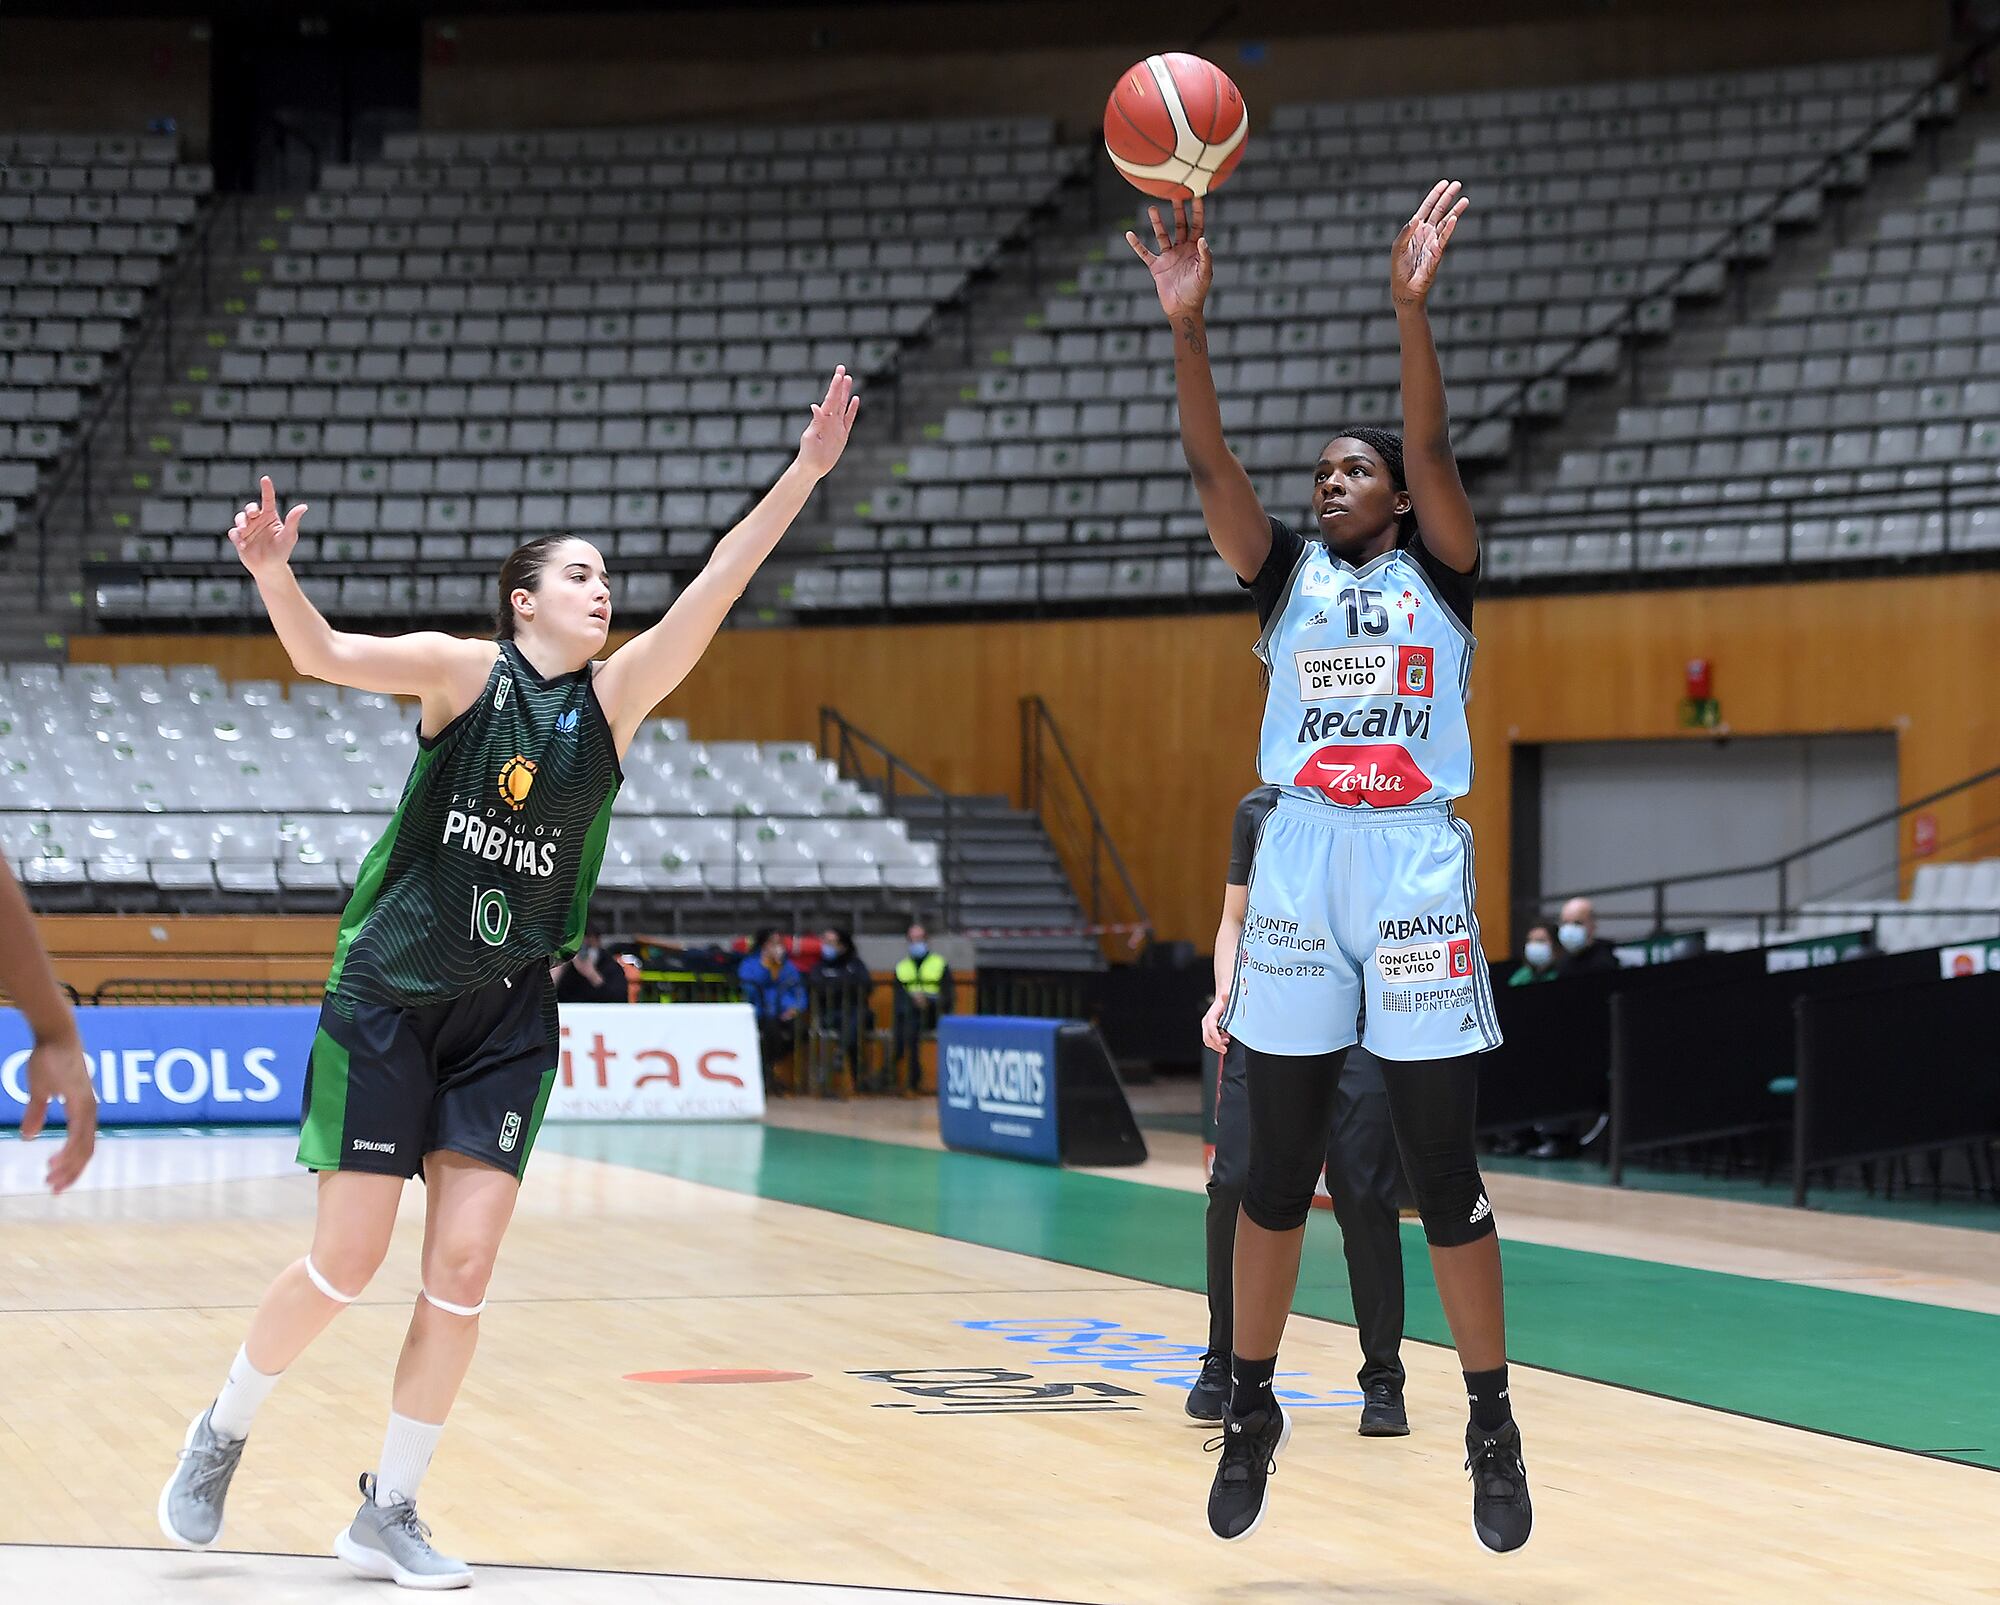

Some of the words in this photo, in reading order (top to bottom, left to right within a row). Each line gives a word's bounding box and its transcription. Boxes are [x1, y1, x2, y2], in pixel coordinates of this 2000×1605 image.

[1337, 588, 1389, 637] 15
[1304, 655, 1386, 674] CONCELLO
[1312, 675, 1332, 689] DE
[1338, 672, 1376, 687] VIGO
[1297, 702, 1432, 743] Recalvi
[1316, 760, 1405, 792] Zorka
[470, 885, 511, 946] 10
[1255, 914, 1299, 935] XUNTA
[1268, 933, 1325, 952] GALICIA
[1379, 949, 1441, 965] CONCELLO
[1385, 967, 1401, 976] DE
[1405, 963, 1434, 974] VIGO
[0, 1047, 281, 1104] GIFOLS
[352, 1138, 396, 1154] SPALDING
